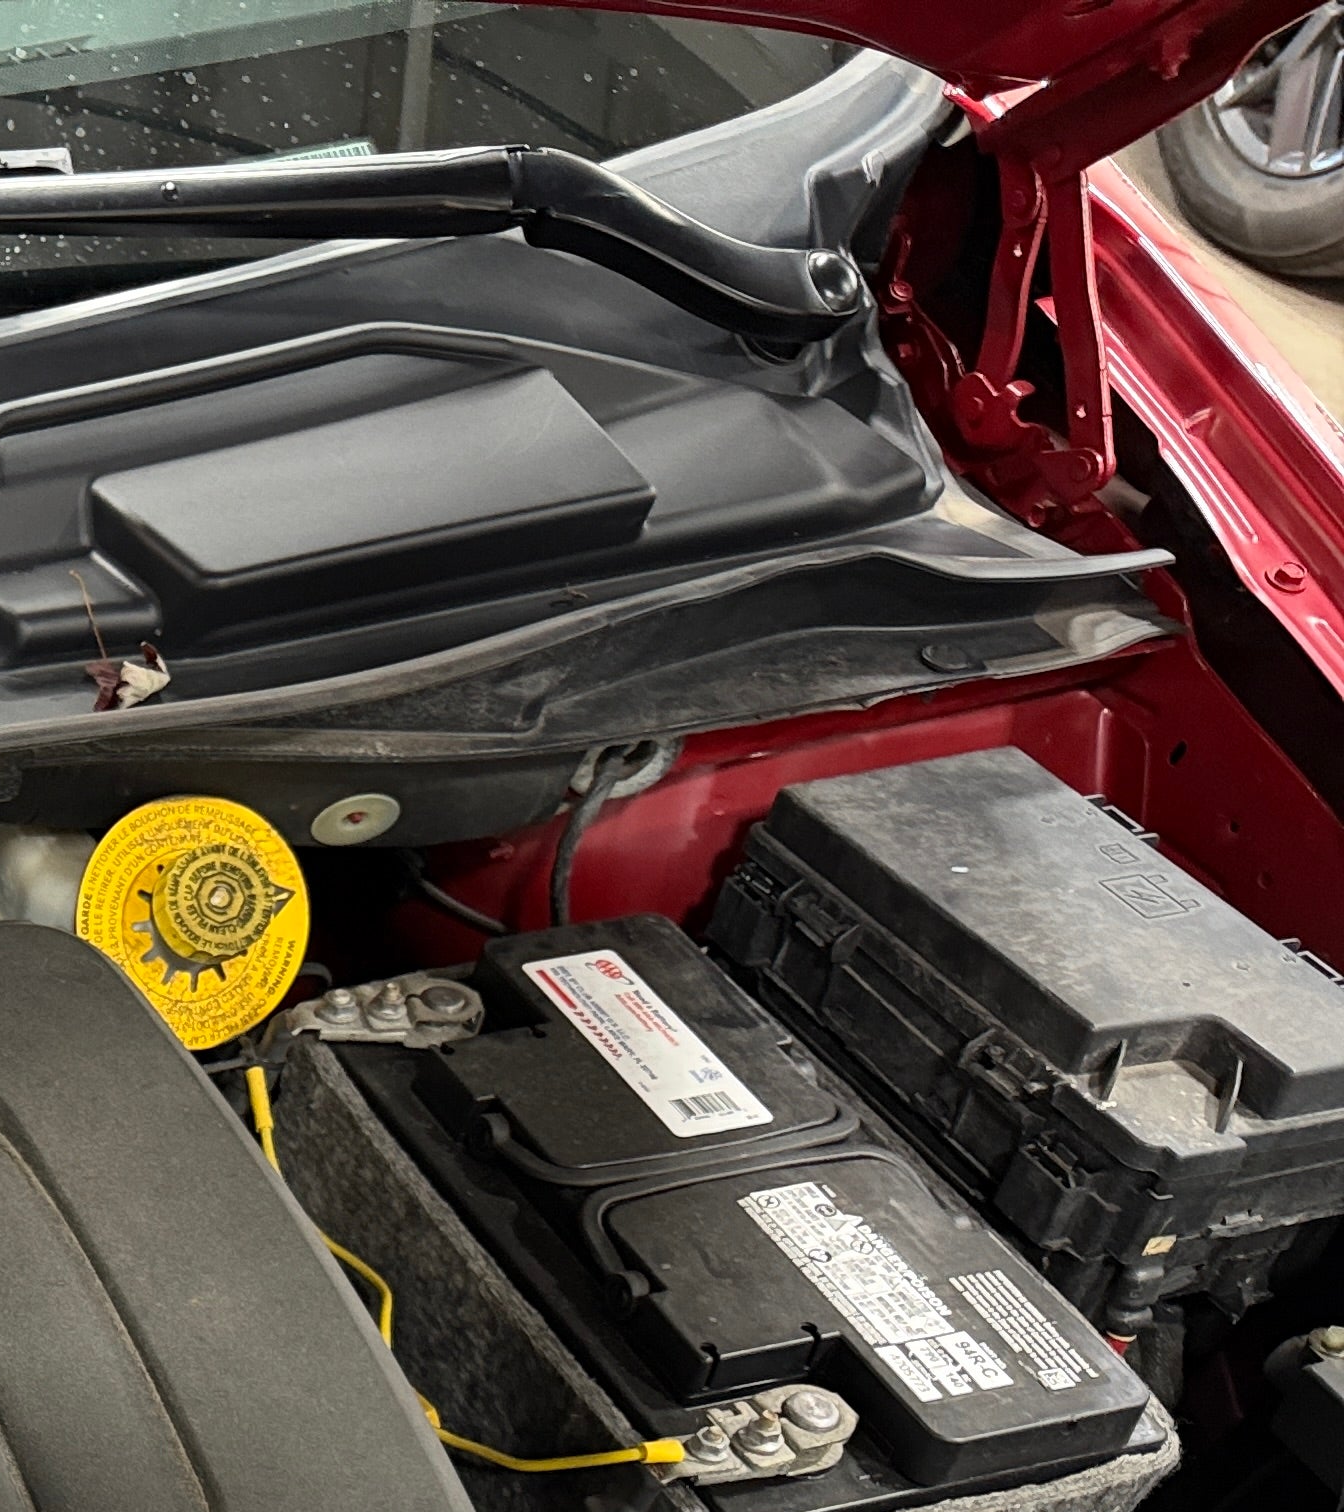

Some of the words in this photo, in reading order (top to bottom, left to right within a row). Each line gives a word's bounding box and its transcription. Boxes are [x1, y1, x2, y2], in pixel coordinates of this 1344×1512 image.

[112, 832, 148, 868] UTILISER
[80, 892, 92, 935] GARDE
[90, 837, 119, 885] NETTOYER
[118, 827, 129, 841] LE
[129, 806, 176, 833] BOUCHON
[265, 939, 297, 998] WARNING:
[955, 1341, 998, 1378] 94R-C
[947, 1372, 964, 1387] 140
